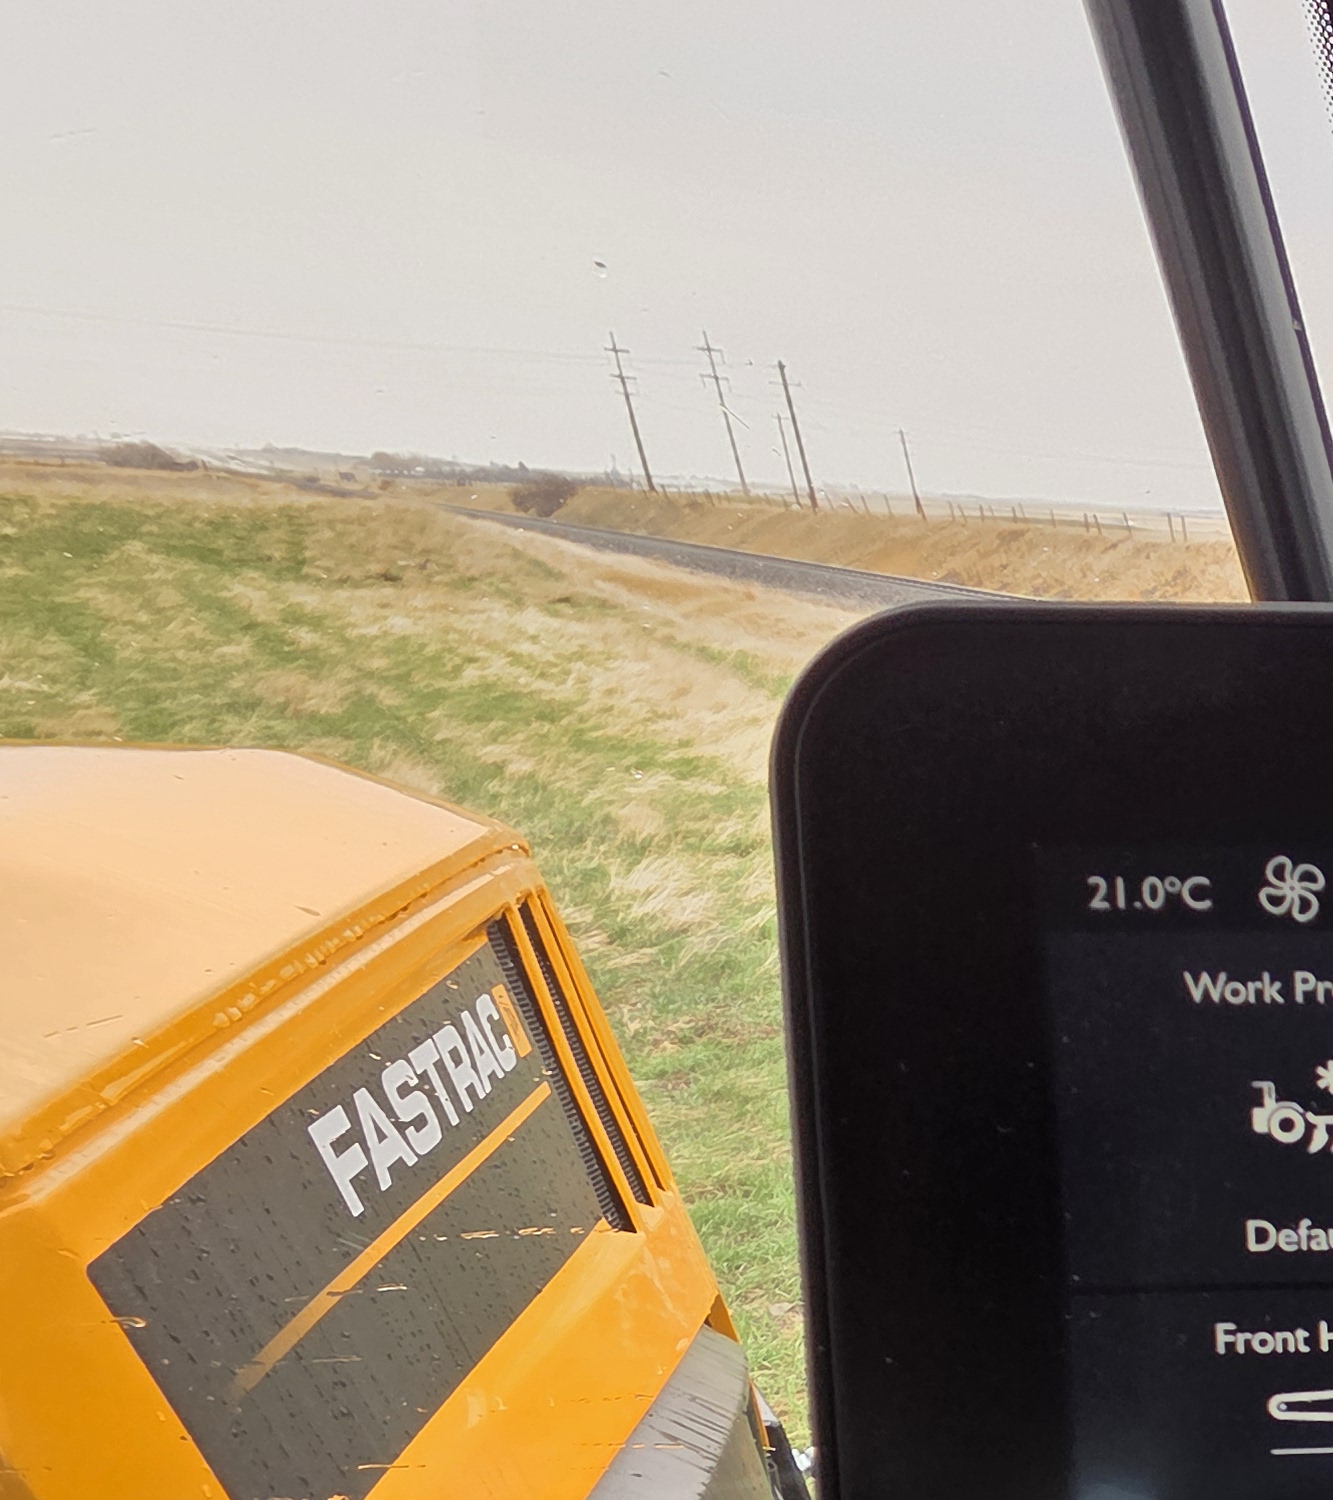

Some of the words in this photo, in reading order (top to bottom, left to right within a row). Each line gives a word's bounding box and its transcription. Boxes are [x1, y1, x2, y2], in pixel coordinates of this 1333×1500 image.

[1183, 971, 1284, 1004] Work
[307, 993, 518, 1218] FASTRAC
[1215, 1321, 1310, 1355] Front
